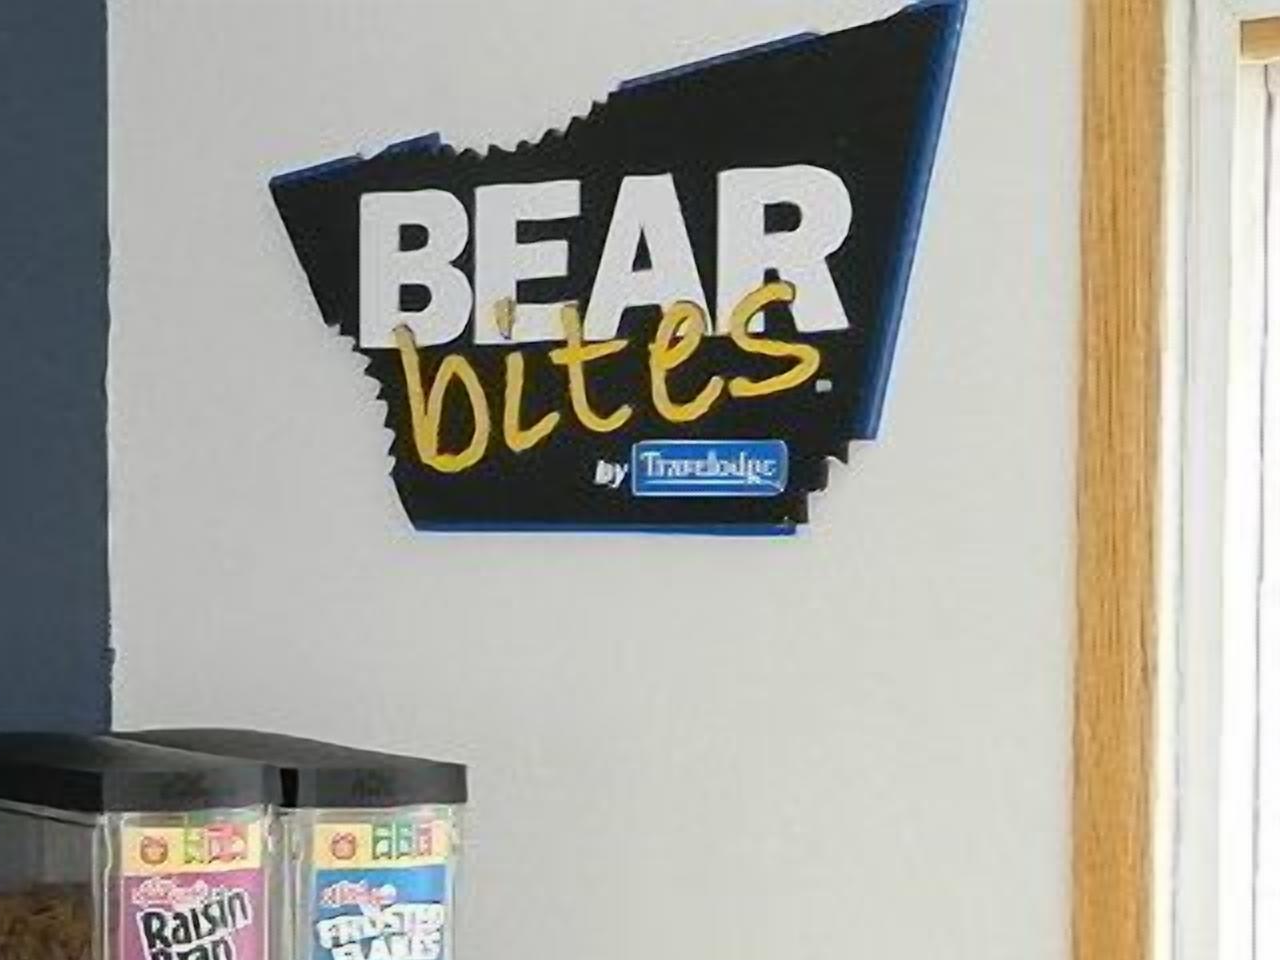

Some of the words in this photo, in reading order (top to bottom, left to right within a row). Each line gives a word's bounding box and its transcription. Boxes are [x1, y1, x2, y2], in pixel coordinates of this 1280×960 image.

[358, 164, 853, 349] BEAR
[392, 280, 820, 472] bites
[594, 459, 628, 488] by
[139, 890, 250, 949] Raisin
